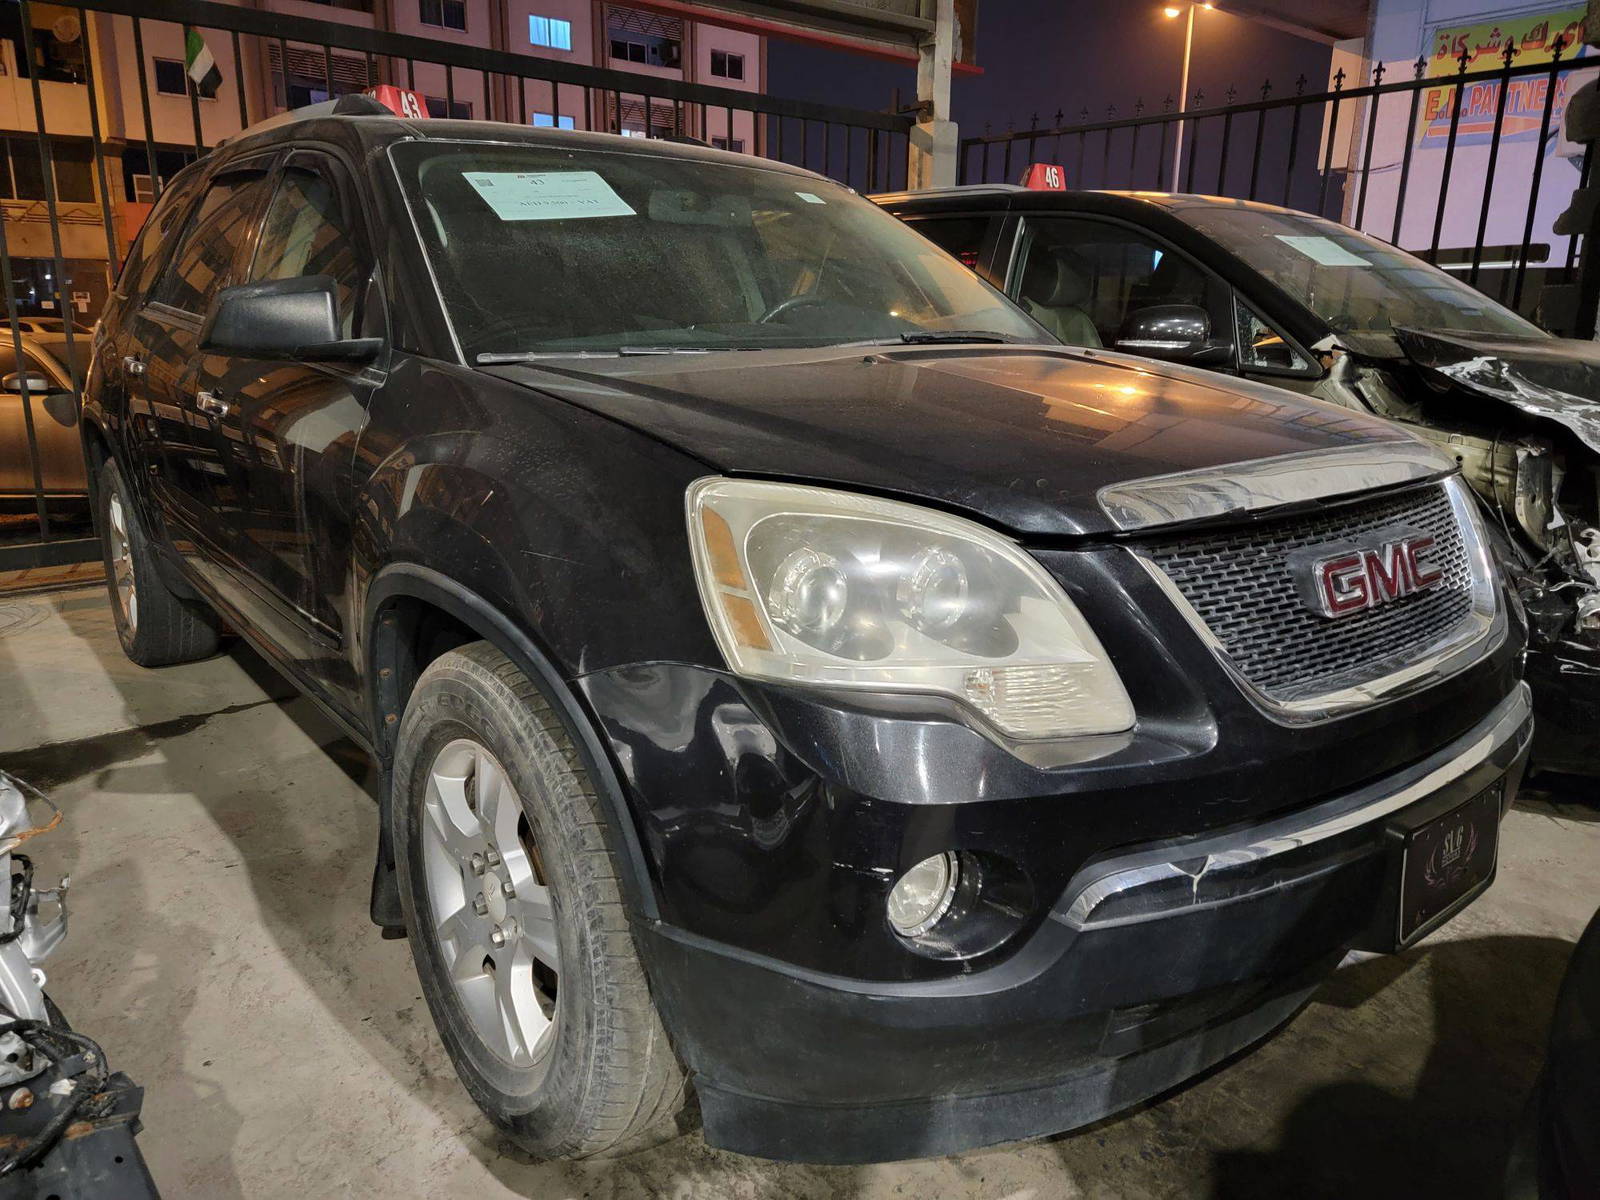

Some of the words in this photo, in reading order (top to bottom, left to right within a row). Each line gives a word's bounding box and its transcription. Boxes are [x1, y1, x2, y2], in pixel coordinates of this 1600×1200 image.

[401, 91, 423, 120] 43
[1045, 166, 1060, 188] 46
[1312, 537, 1443, 618] GMC
